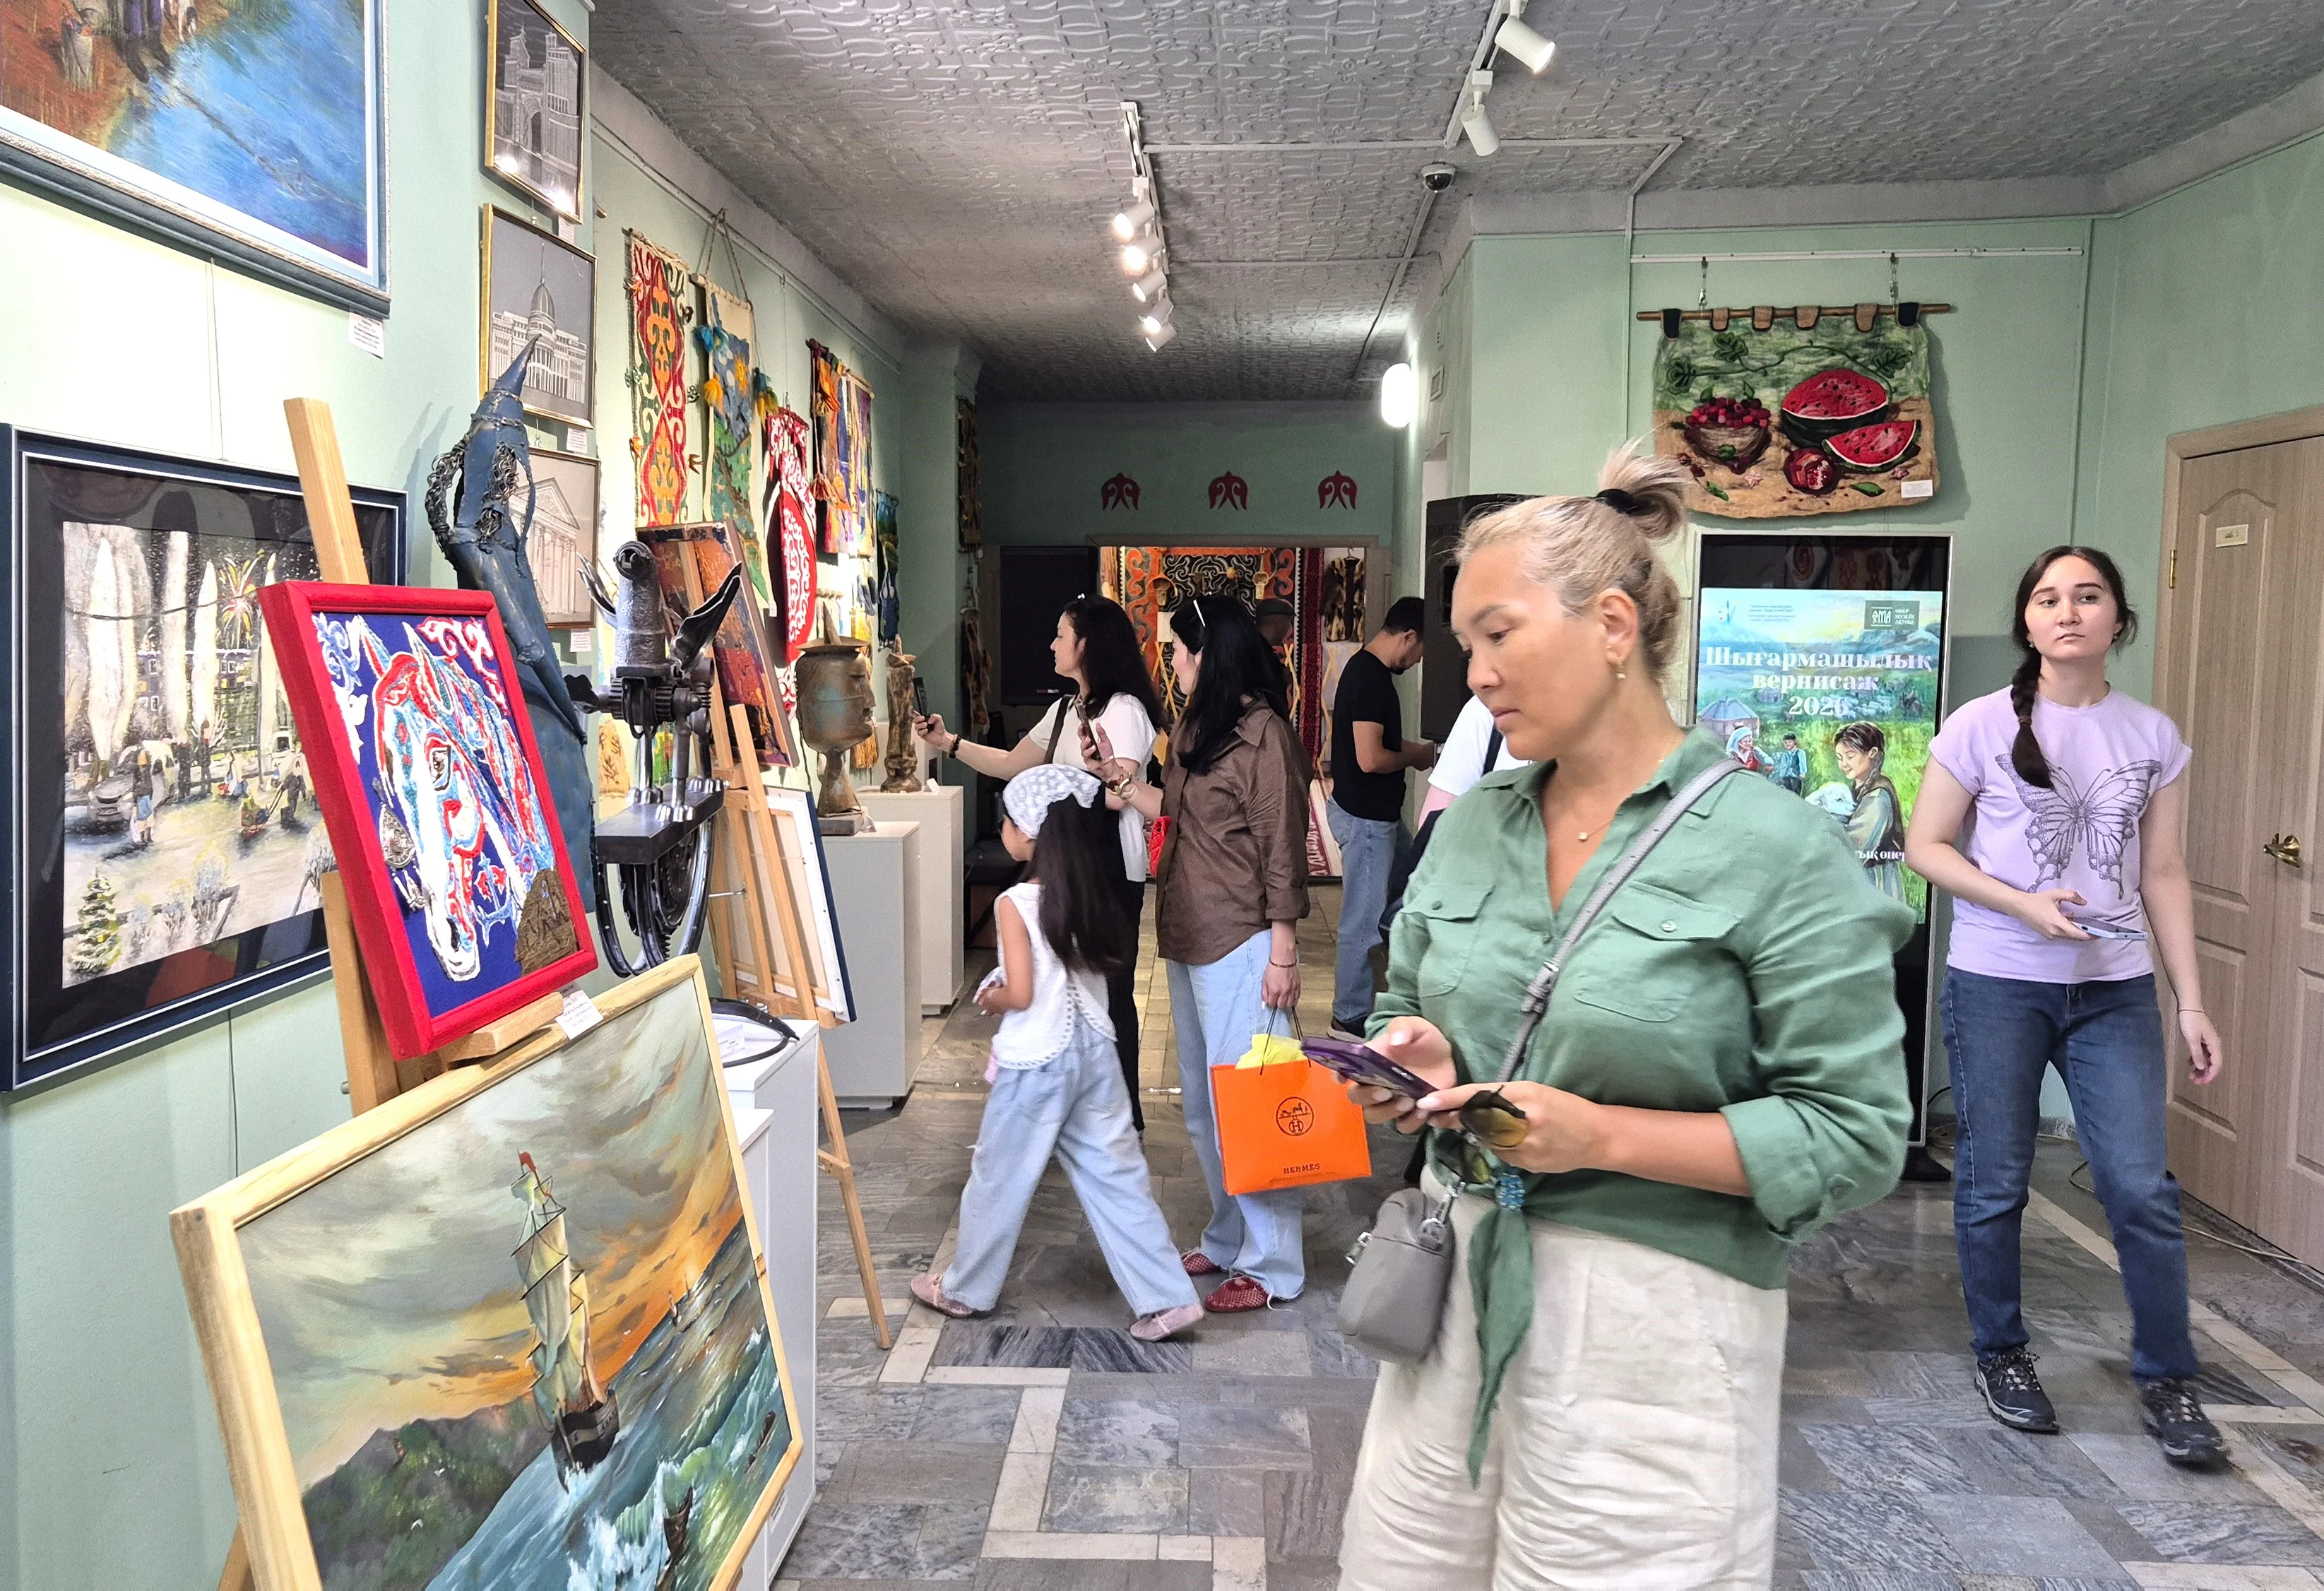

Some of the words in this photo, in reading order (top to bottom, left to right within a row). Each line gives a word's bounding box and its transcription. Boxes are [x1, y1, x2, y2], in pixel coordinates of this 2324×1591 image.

[1705, 646, 1933, 673] Шығармашылық
[1752, 673, 1879, 694] вернисаж
[1789, 695, 1849, 716] 2026
[1283, 1163, 1320, 1173] HERMES
